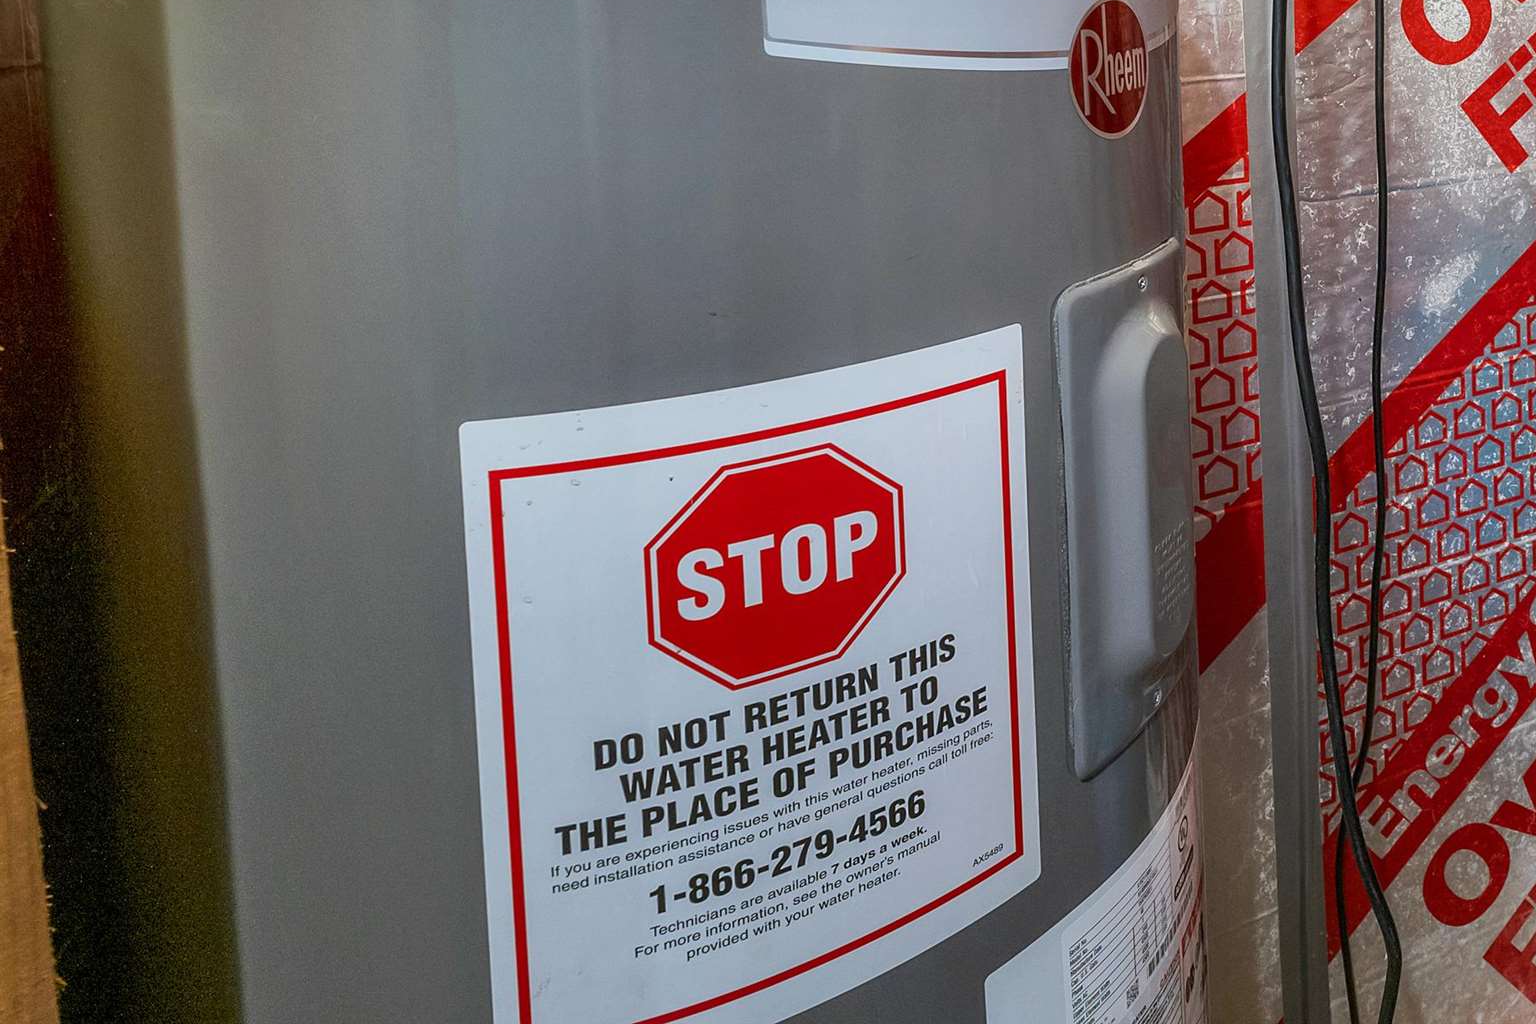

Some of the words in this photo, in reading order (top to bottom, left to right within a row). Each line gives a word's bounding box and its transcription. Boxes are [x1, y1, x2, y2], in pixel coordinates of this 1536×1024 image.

[1080, 4, 1145, 117] Rheem
[676, 509, 879, 621] STOP
[593, 732, 645, 772] DO
[658, 710, 731, 758] NOT
[744, 666, 880, 735] RETURN
[889, 633, 957, 684] THIS
[620, 744, 749, 804] WATER
[762, 696, 891, 766] HEATER
[901, 675, 939, 714] TO
[550, 866, 561, 878] If
[564, 862, 592, 877] you
[596, 854, 621, 869] are
[625, 826, 719, 862] experiencing
[723, 814, 769, 835] issues
[773, 800, 801, 818] with
[805, 791, 829, 807] this
[832, 775, 868, 796] water
[871, 757, 914, 781] heater,
[917, 734, 961, 761] missing
[963, 719, 993, 744] parts,
[552, 877, 590, 894] need
[593, 859, 674, 885] installation
[678, 833, 755, 864] assistance
[759, 827, 774, 839] or
[777, 813, 811, 833] have
[814, 793, 864, 821] general
[867, 768, 925, 798] questions
[928, 753, 948, 771] call
[951, 744, 968, 760] toll
[970, 732, 994, 750] free:
[555, 813, 628, 856] THE
[641, 777, 760, 838] PLACE
[772, 758, 817, 798] OF
[828, 687, 989, 779] PURCHASE
[634, 946, 660, 960] For
[663, 932, 701, 951] more
[705, 902, 790, 938] information,
[792, 890, 818, 906] see
[821, 879, 843, 896] the
[845, 857, 895, 884] owner's
[896, 832, 942, 862] manual
[649, 789, 926, 914] 1-866-279-4566
[650, 903, 737, 937] Technicians
[740, 895, 764, 909] are
[767, 869, 828, 899] available
[830, 863, 841, 875] 7
[843, 850, 877, 872] days
[879, 843, 888, 854] a
[891, 826, 928, 848] week.
[685, 931, 750, 962] provided
[752, 918, 782, 936] with
[784, 905, 817, 929] your
[818, 889, 857, 910] water
[857, 867, 902, 894] heater.
